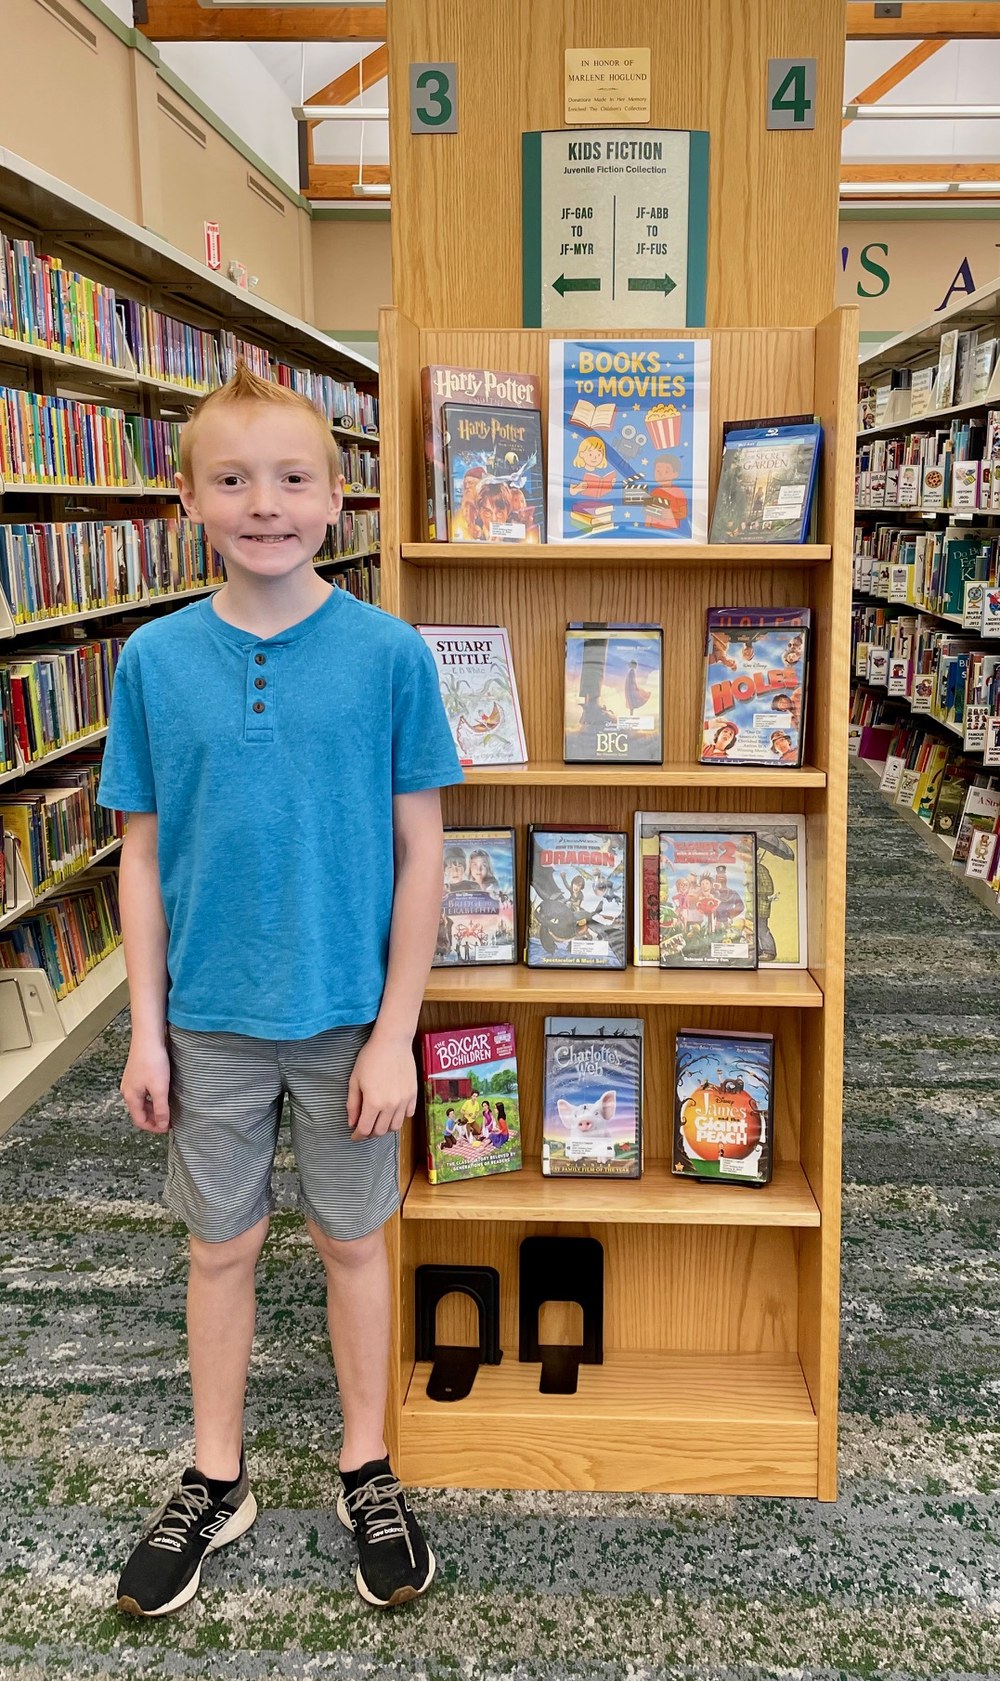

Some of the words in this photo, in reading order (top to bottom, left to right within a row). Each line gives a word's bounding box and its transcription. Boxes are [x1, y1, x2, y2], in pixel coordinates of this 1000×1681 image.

[568, 74, 605, 82] MARLENE
[609, 73, 647, 81] HOGLUND
[416, 70, 452, 126] 3
[771, 66, 812, 122] 4
[568, 141, 602, 161] KIDS
[606, 141, 663, 160] FICTION
[563, 166, 595, 175] Juvenile
[596, 165, 624, 174] Fiction
[625, 165, 667, 174] Collection
[561, 207, 593, 220] JF-GAG
[636, 207, 669, 219] JF-ABB
[571, 225, 583, 237] TO
[646, 225, 658, 237] TO
[559, 243, 594, 255] JF-MYR
[636, 243, 668, 255] JF-FUS
[579, 351, 661, 374] BOOKS
[433, 370, 483, 398] Harry
[483, 371, 535, 405] Potter
[575, 380, 594, 394] TO
[597, 375, 686, 398] MOVIES
[458, 419, 491, 441] Harry
[490, 417, 526, 444] Potter
[743, 458, 788, 471] GARDEN
[436, 640, 493, 652] STUART
[441, 653, 493, 665] LITTLE
[710, 668, 798, 716] HOLES
[596, 732, 629, 753] BFG
[540, 850, 615, 868] DRAGON
[719, 841, 737, 864] 2
[434, 1040, 445, 1050] THE
[436, 1034, 491, 1069] BOXCAR
[451, 1049, 492, 1067] CHILDREN
[554, 1043, 623, 1067] Charlotte's
[576, 1061, 604, 1082] Web
[695, 1092, 747, 1118] James
[696, 1131, 748, 1145] PEACH
[372, 1530, 384, 1539] new
[383, 1527, 404, 1535] balanc
